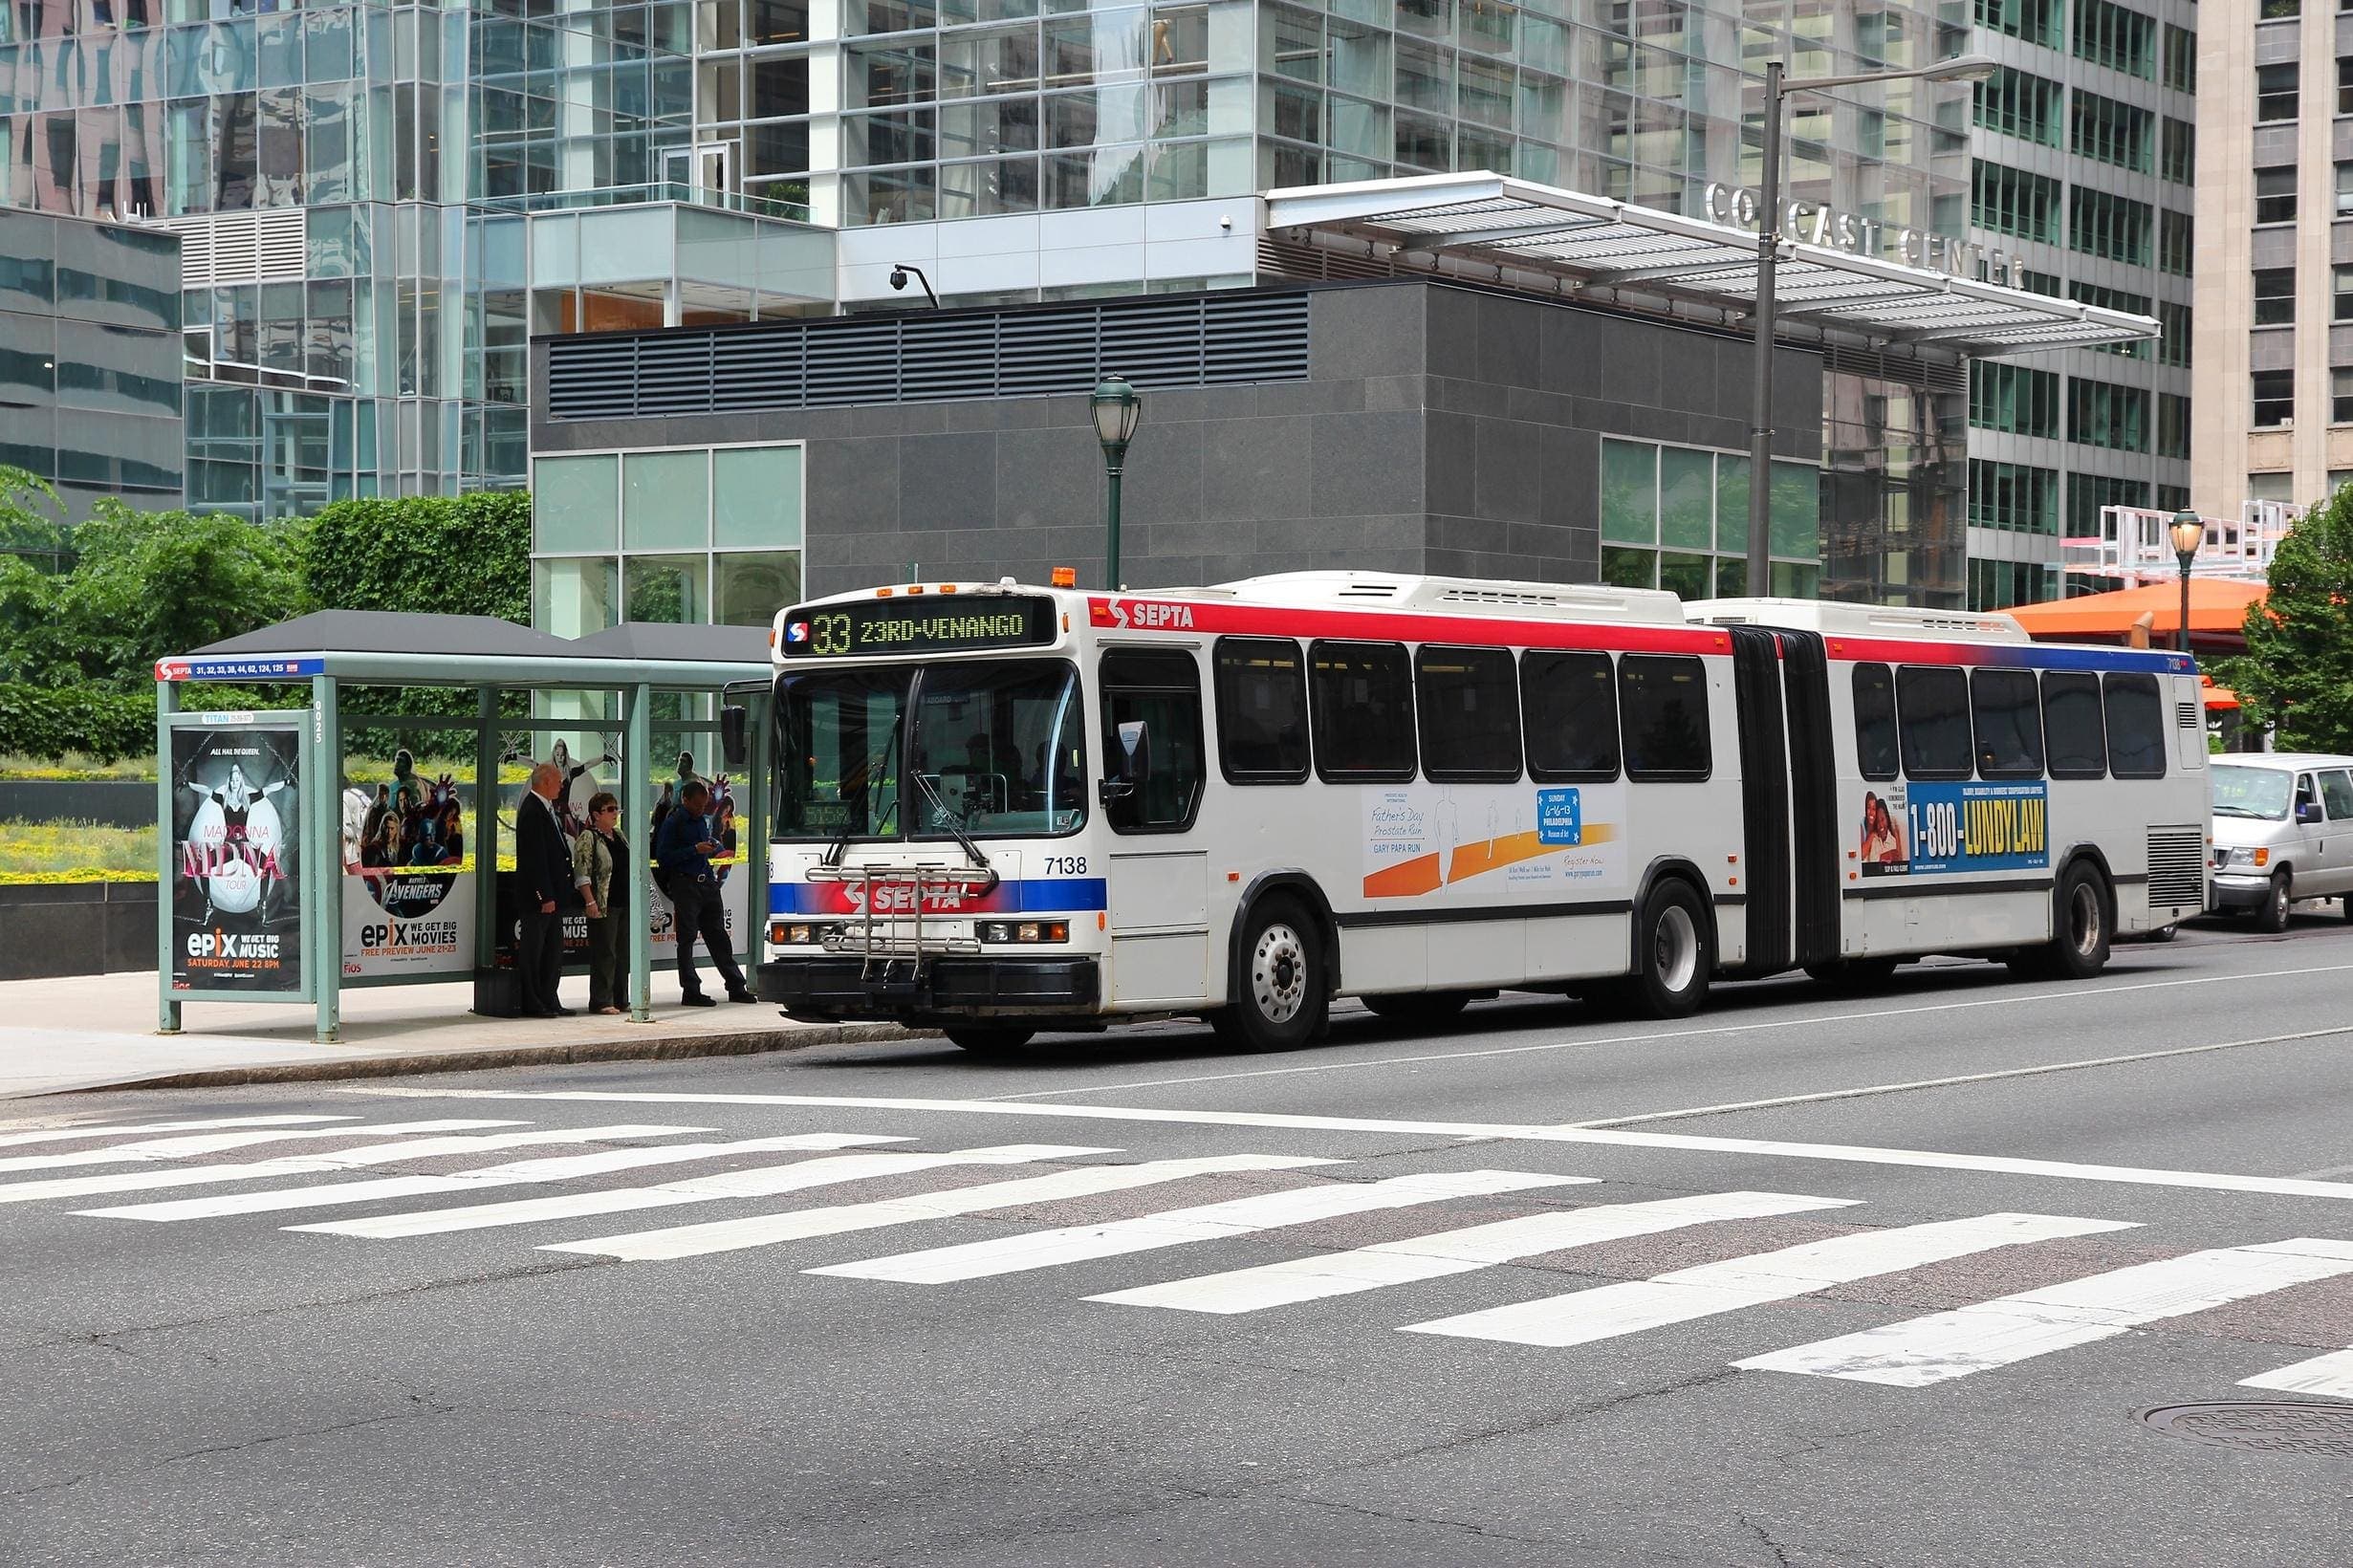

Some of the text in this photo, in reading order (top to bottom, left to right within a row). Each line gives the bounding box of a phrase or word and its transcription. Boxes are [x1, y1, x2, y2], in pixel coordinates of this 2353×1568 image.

[1706, 183, 2024, 290] COCAST CENTER
[1133, 602, 1194, 628] SEPTA
[813, 613, 1023, 654] 33 23RD-VENANGO
[172, 666, 191, 675] SEPTA
[205, 714, 229, 724] TITAN
[1371, 807, 1425, 822] Father's Day
[204, 825, 270, 838] MADONNA
[1375, 824, 1423, 836] Prostate Run
[1373, 843, 1421, 854] GARY PAPA RUN
[180, 840, 288, 879] MDNA
[1044, 857, 1087, 874] 7138
[226, 880, 247, 890] TOUR
[383, 880, 443, 904] AVENGERS
[874, 885, 961, 910] SEPTA
[411, 922, 457, 931] WE GET BIG
[562, 917, 587, 926] WE GET
[411, 931, 457, 946] MOVIES
[562, 926, 588, 939] MUS
[266, 935, 279, 944] BIG
[239, 944, 279, 958] MUSIC
[361, 947, 380, 956] FREE
[382, 947, 414, 956] PREVIEW
[417, 945, 436, 954] JUNE
[187, 958, 279, 969] SATURDAY, JUNE 22 8PM
